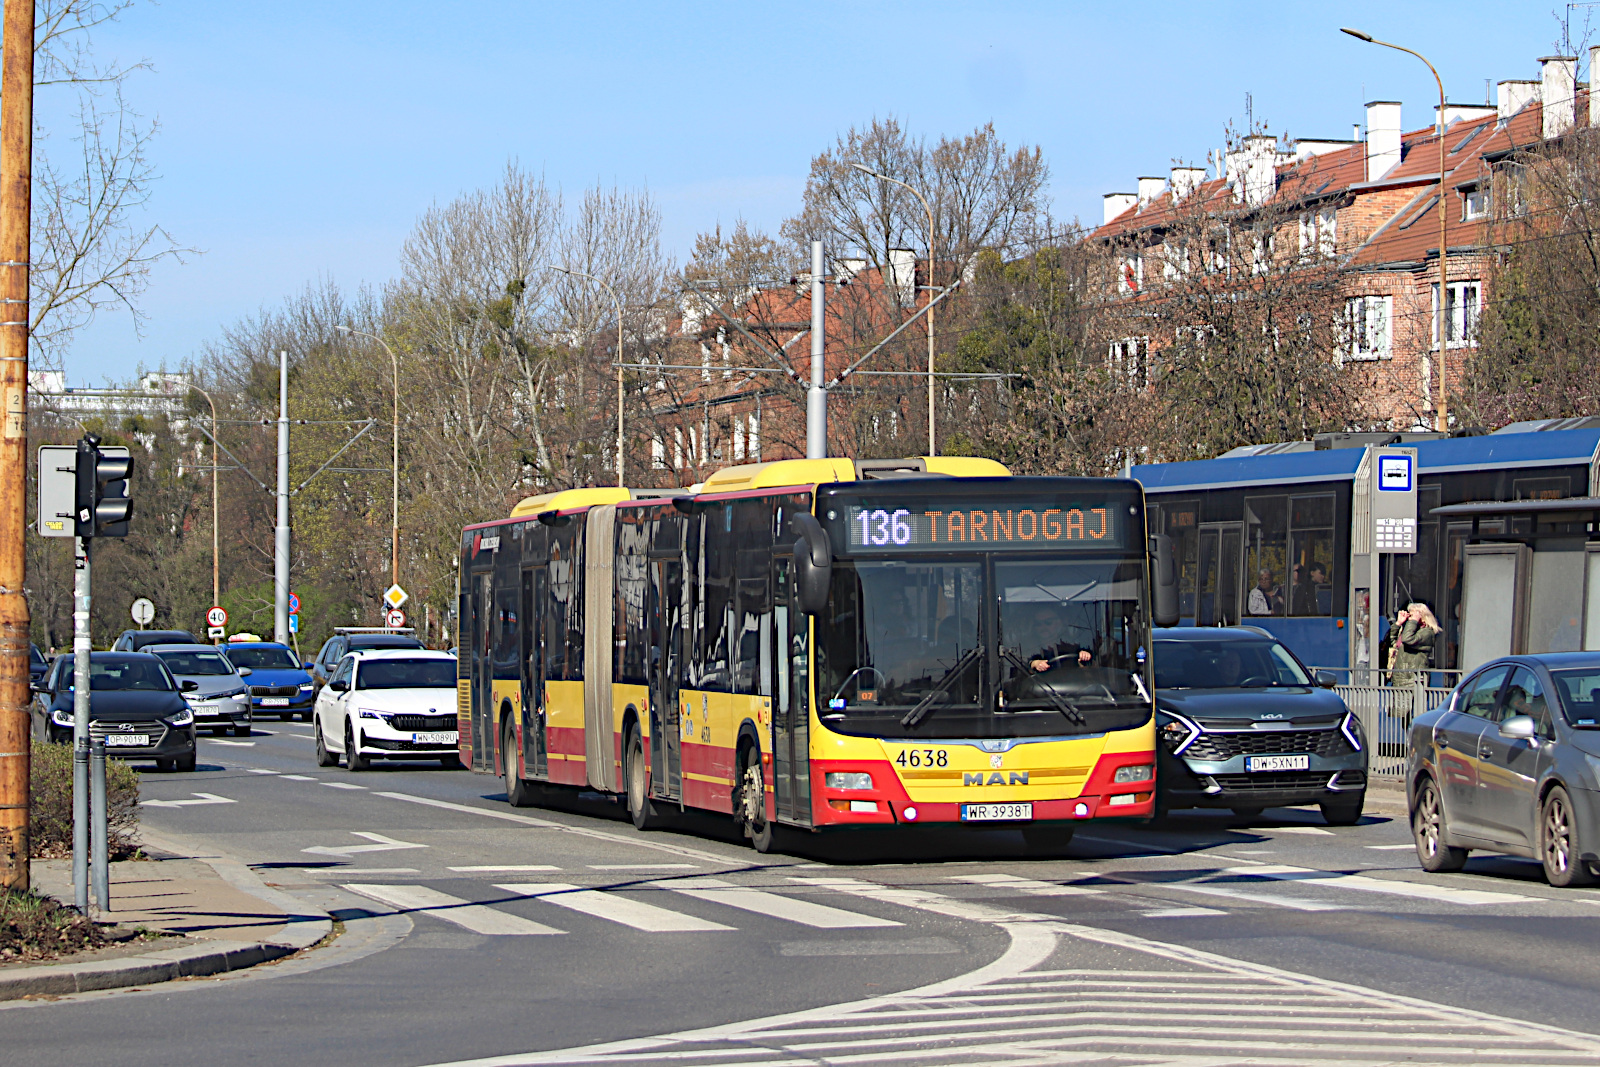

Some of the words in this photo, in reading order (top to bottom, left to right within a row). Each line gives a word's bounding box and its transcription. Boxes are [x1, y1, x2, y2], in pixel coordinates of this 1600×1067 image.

[856, 508, 911, 546] 136
[924, 507, 1107, 542] TARNOGAJ
[209, 611, 225, 622] 40
[861, 692, 873, 700] 07
[896, 749, 948, 768] 4638
[1253, 758, 1268, 769] DW
[963, 771, 1029, 787] MAN
[969, 806, 987, 818] WR
[991, 805, 1029, 818] 3938T
